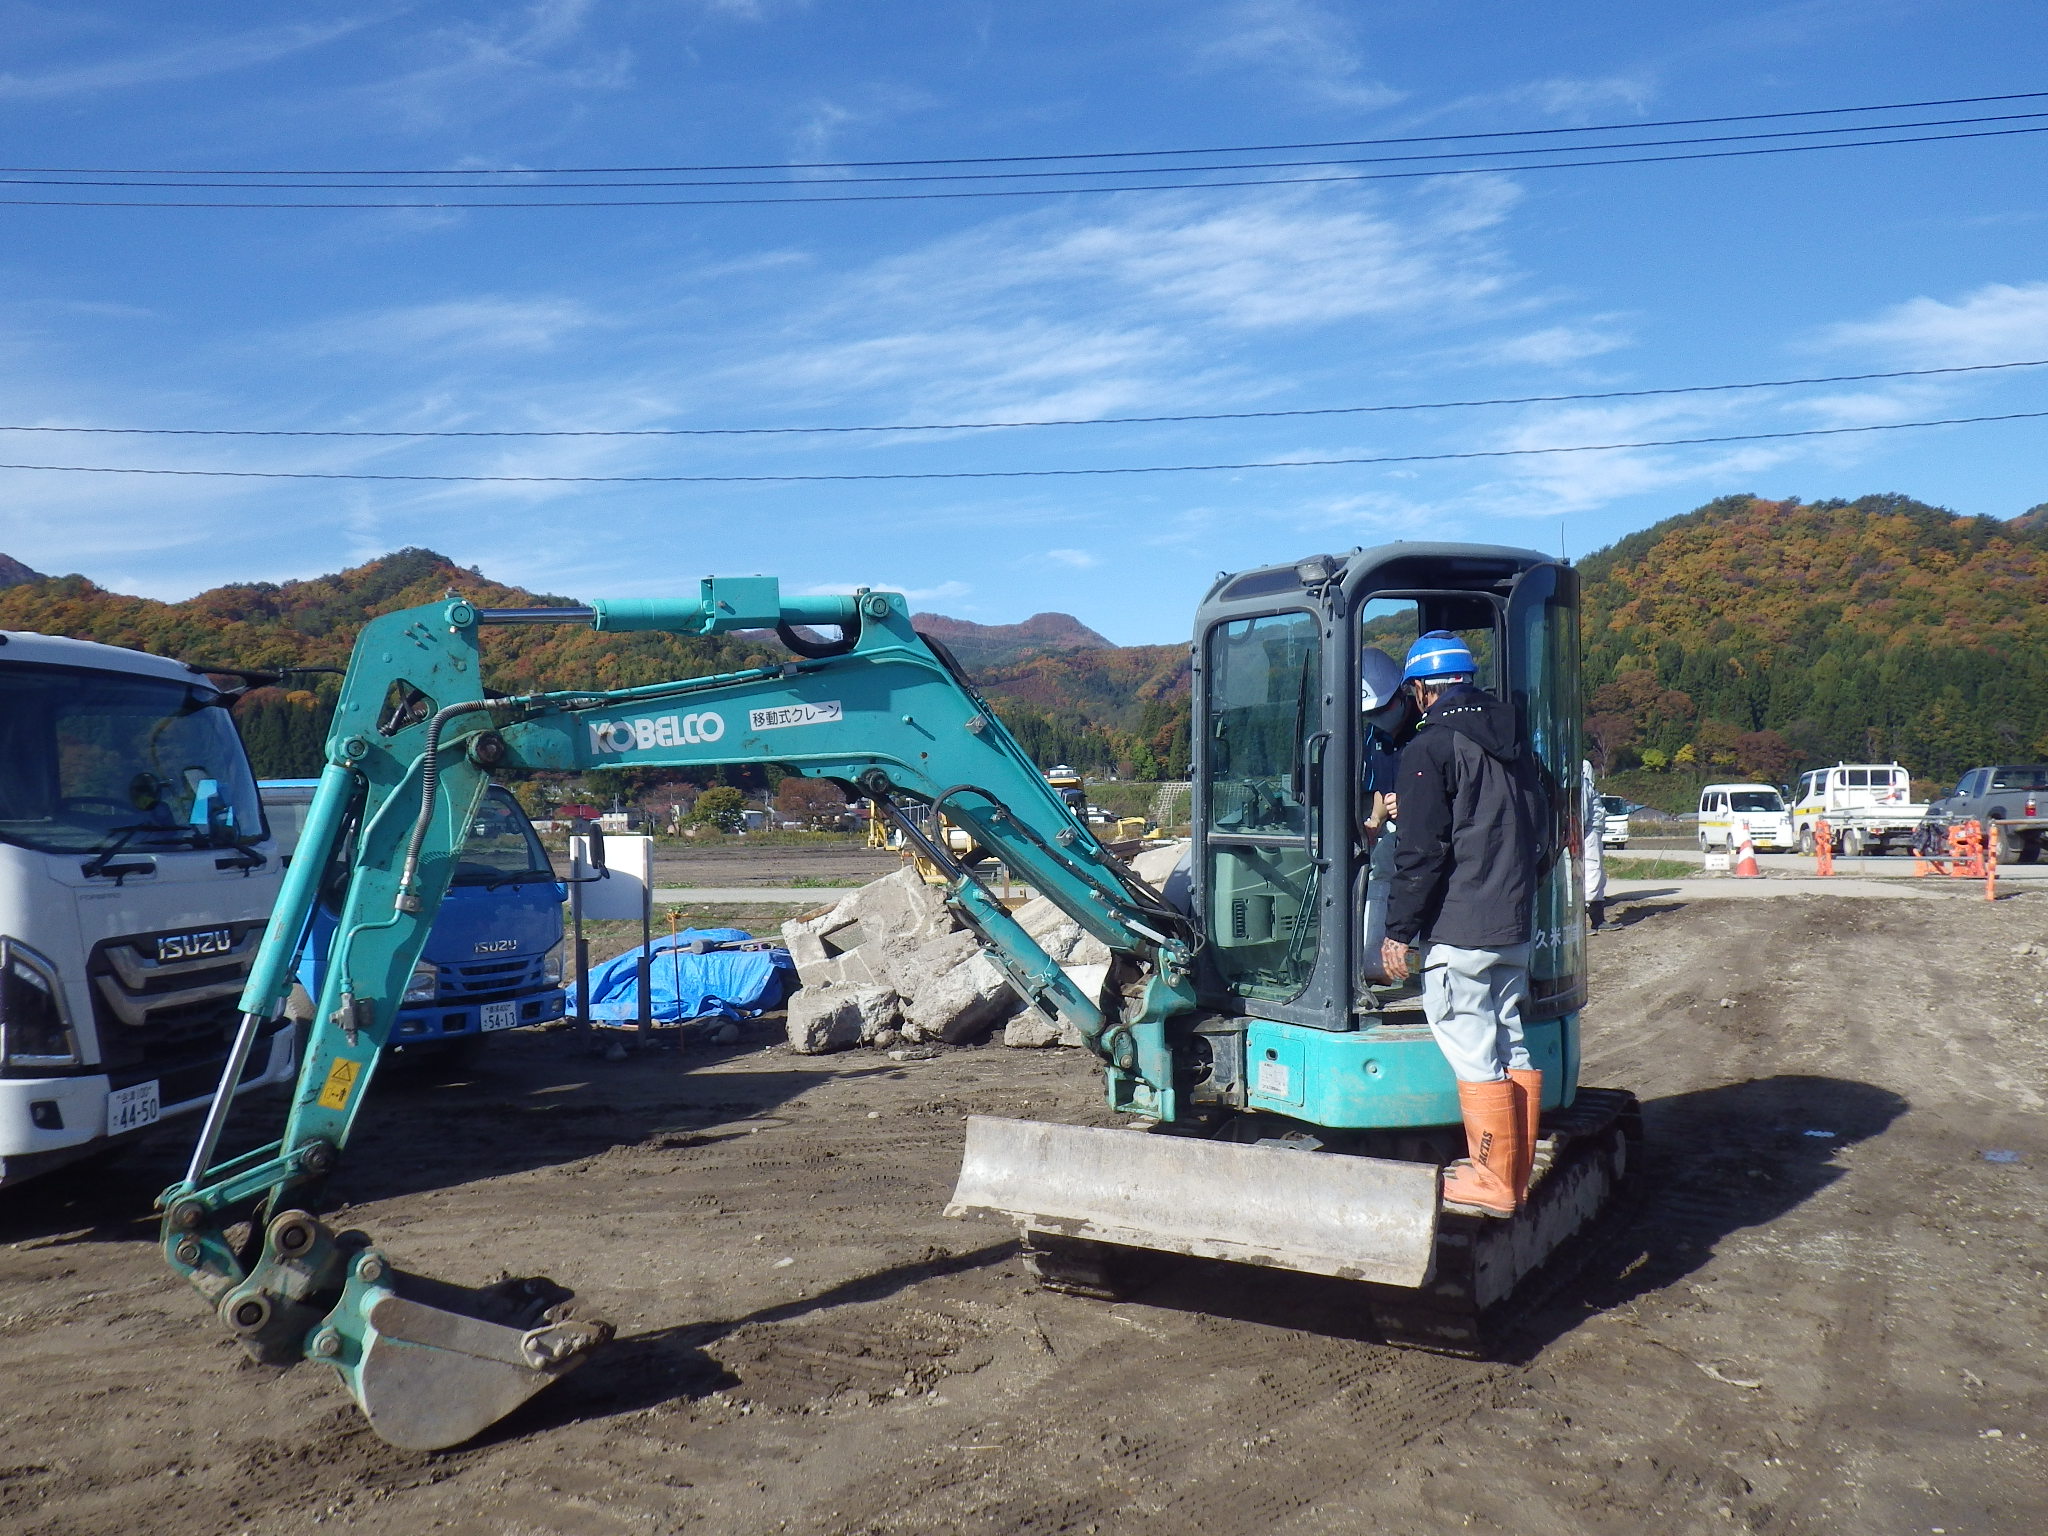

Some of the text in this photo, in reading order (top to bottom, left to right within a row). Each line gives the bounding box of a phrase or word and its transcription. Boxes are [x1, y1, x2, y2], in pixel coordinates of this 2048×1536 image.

[752, 703, 840, 728] 移動式クレーン
[588, 711, 725, 755] KOBELCO
[157, 929, 231, 960] ISUZU
[474, 939, 517, 953] ISUZU
